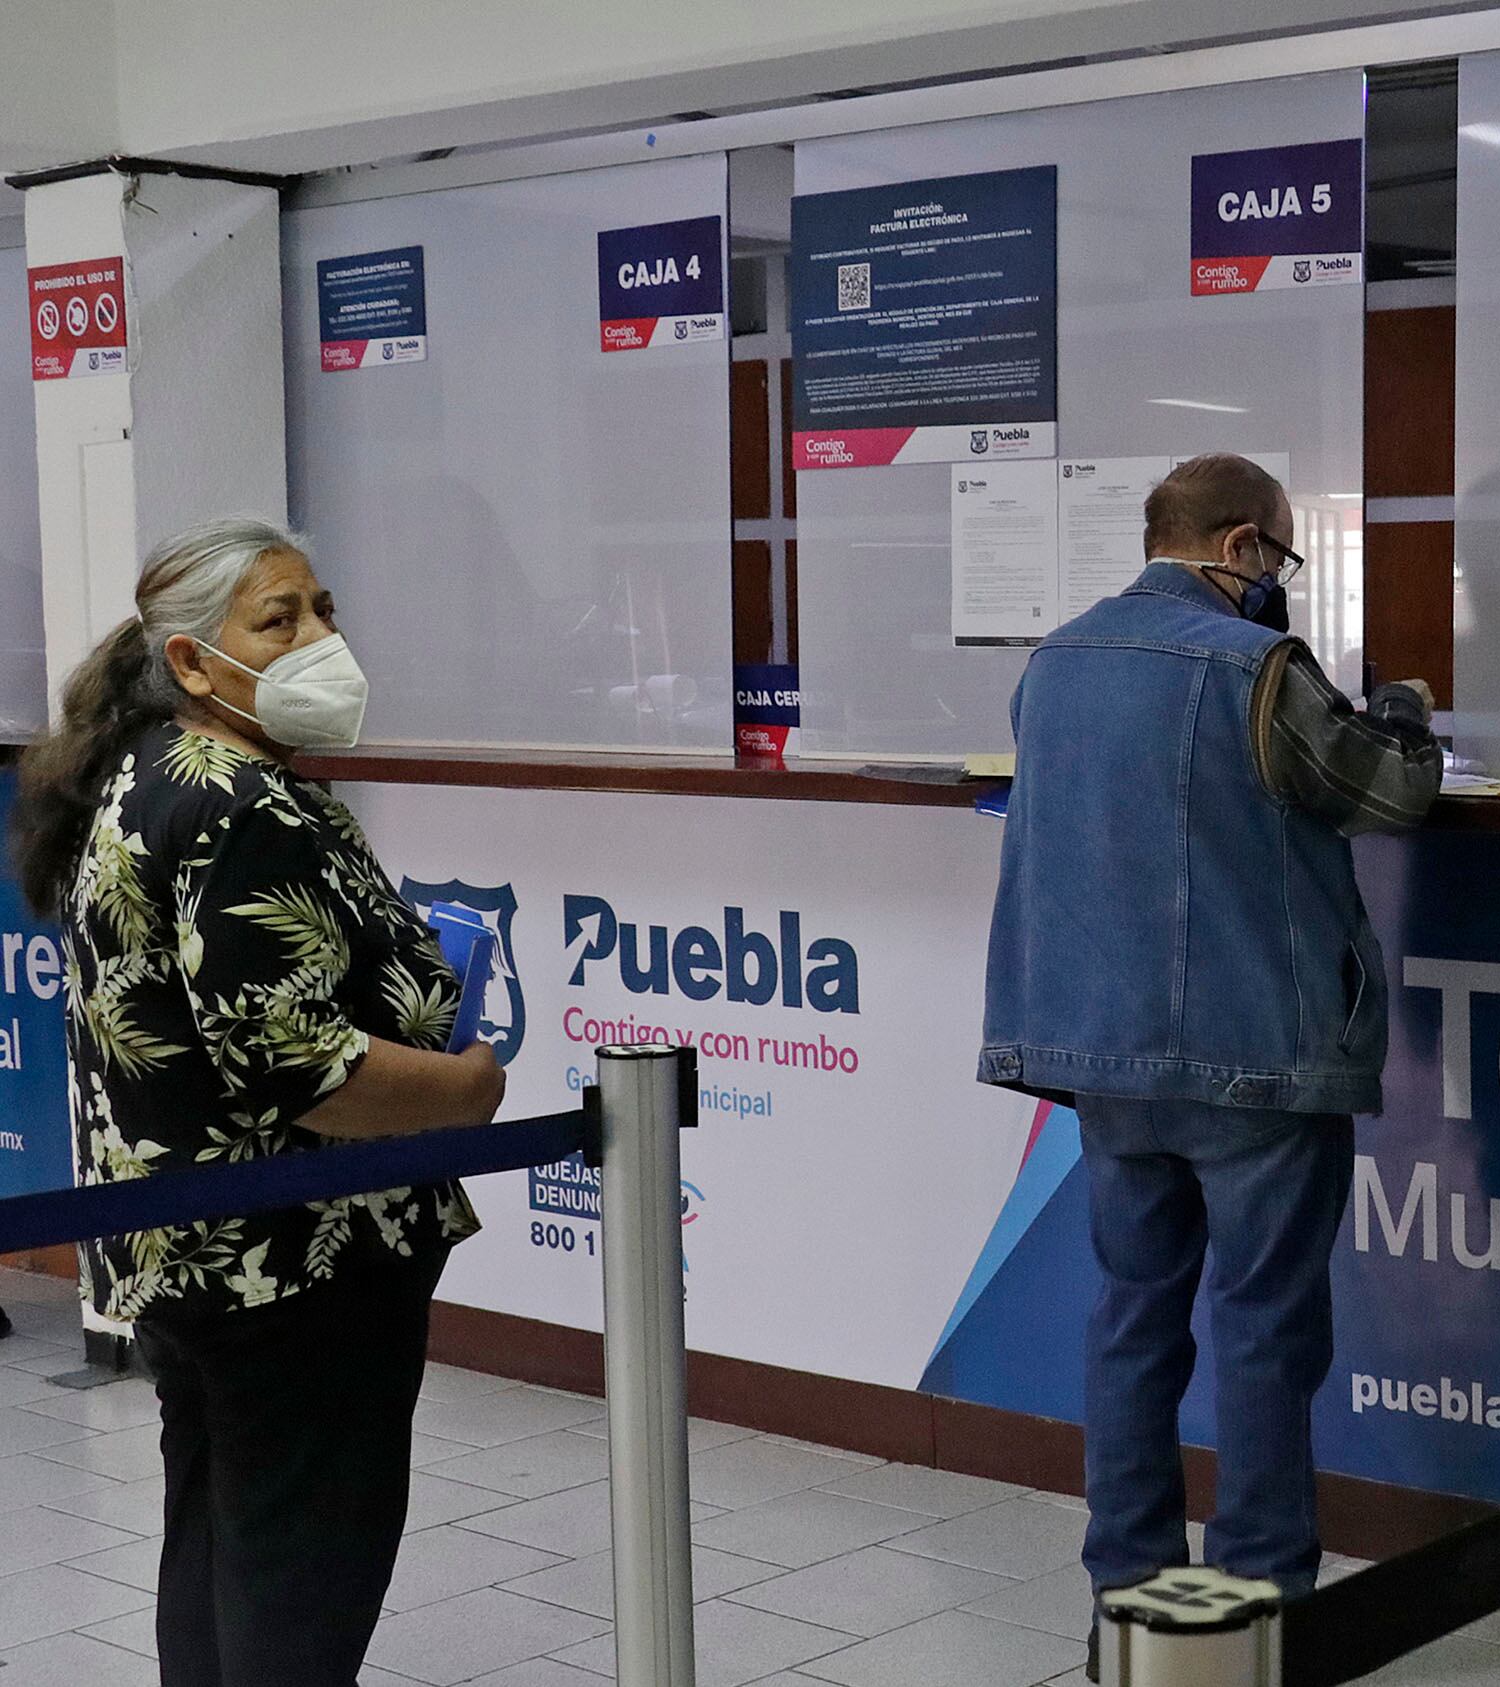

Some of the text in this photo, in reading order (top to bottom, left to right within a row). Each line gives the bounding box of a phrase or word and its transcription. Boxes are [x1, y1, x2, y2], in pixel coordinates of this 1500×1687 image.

[894, 202, 944, 219] INVITACIÓN:
[1218, 184, 1332, 222] CAJA 5
[870, 213, 968, 234] FACTURA ELECTRÓNICA
[1316, 258, 1352, 270] Puebla
[618, 255, 701, 289] CAJA 4
[1197, 265, 1238, 280] Contigo
[35, 270, 115, 291] PROHIBIDO EL USO DE
[1212, 276, 1247, 290] rumbo
[691, 318, 716, 328] Puebla
[605, 326, 635, 341] Contigo
[396, 340, 418, 350] Puebla
[616, 336, 642, 347] rumbo
[993, 428, 1029, 441] Puebla
[806, 439, 845, 454] Contigo
[821, 450, 853, 464] rumbo
[281, 698, 311, 709] KN95
[736, 690, 772, 706] CAJA
[563, 893, 861, 1015] Puebla
[563, 1007, 859, 1074] Contigo y con rumbo
[700, 1084, 772, 1120] nicipal
[530, 1220, 595, 1256] 800 1
